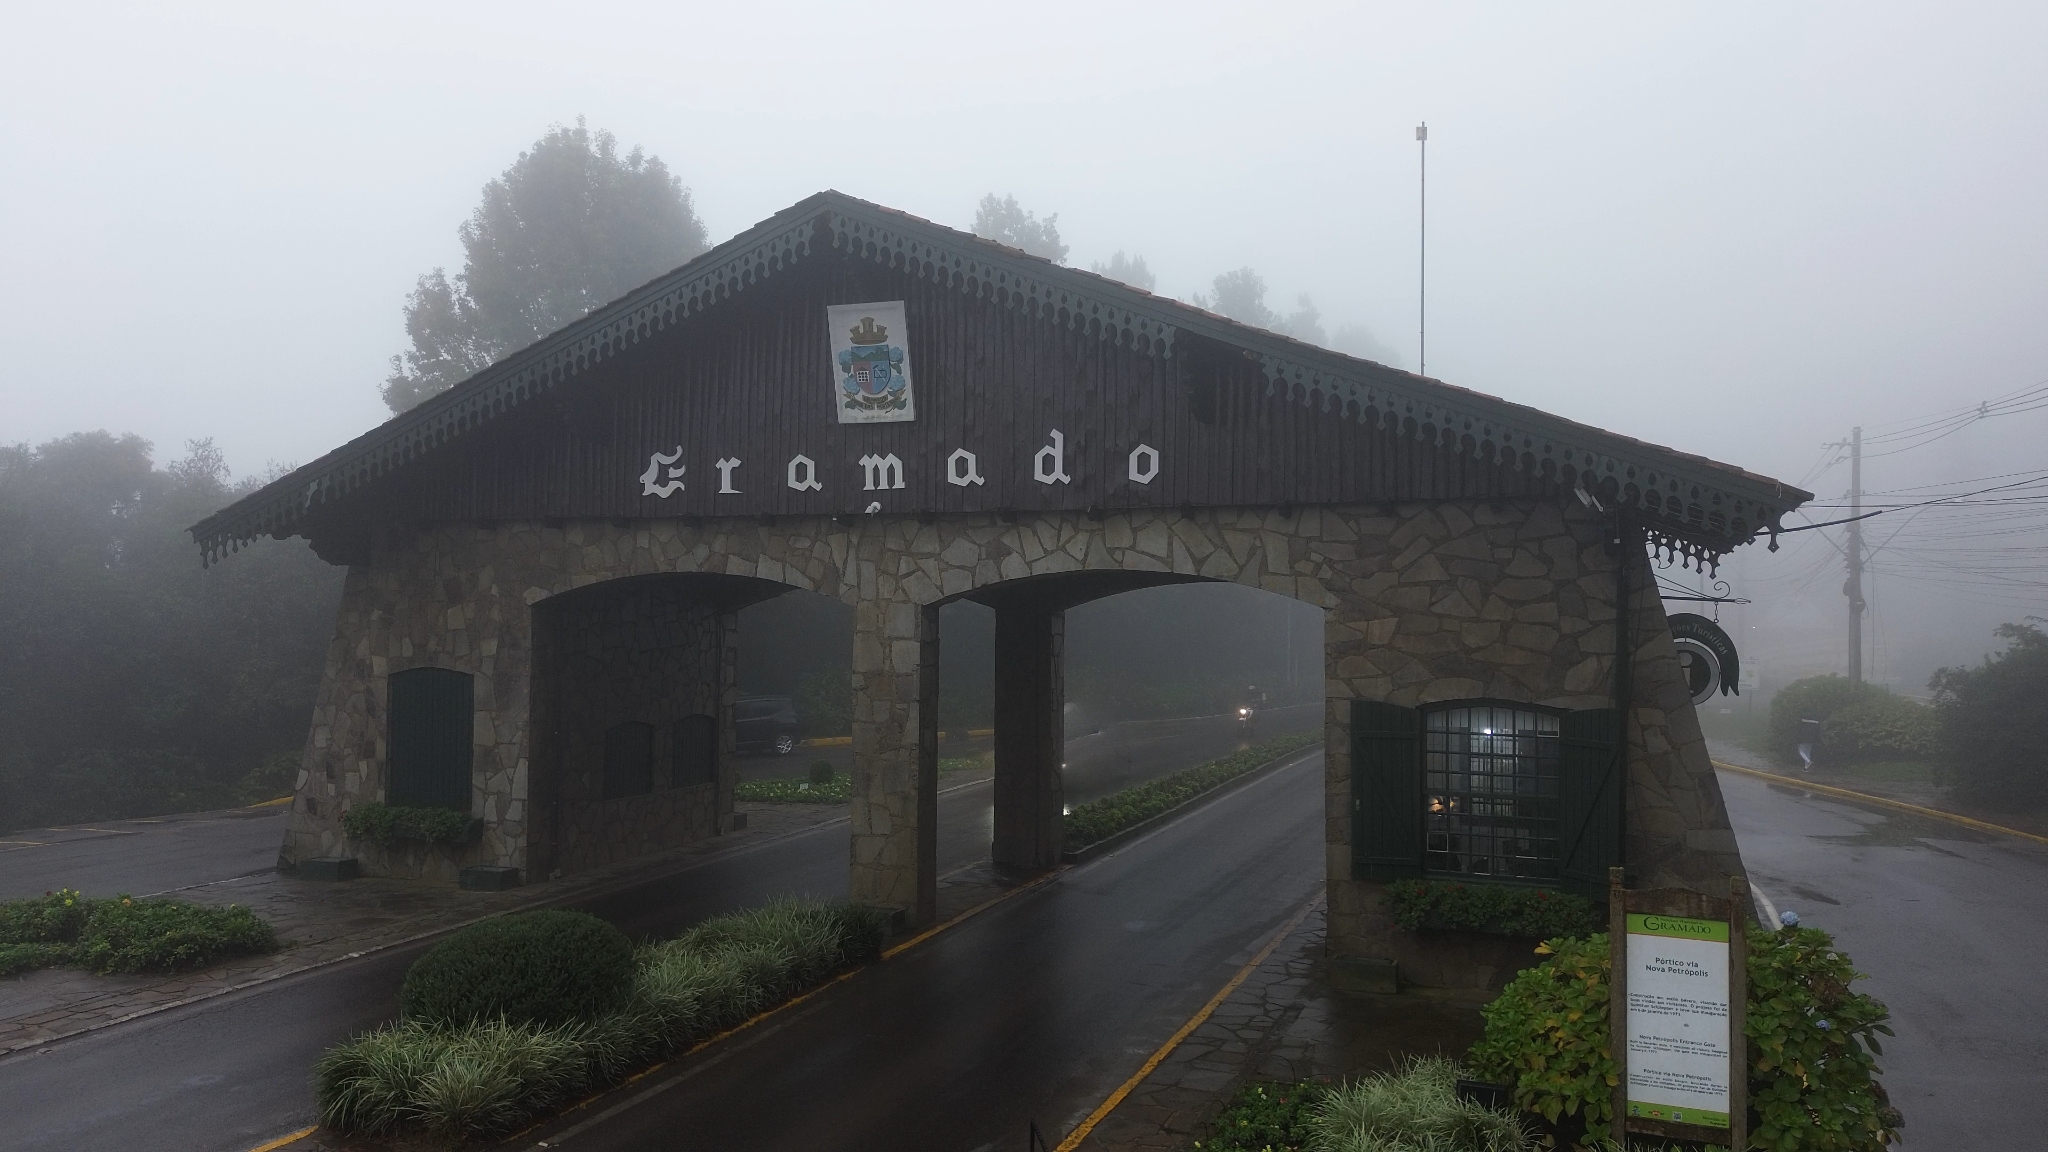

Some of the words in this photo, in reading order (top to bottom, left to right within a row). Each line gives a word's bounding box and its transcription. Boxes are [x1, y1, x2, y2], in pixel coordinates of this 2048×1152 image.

[640, 429, 1160, 499] Gramado
[1643, 916, 1711, 933] GRAMADO
[1655, 957, 1684, 966] Pórtico
[1645, 964, 1666, 973] Nova
[1668, 967, 1709, 977] Petrópolis
